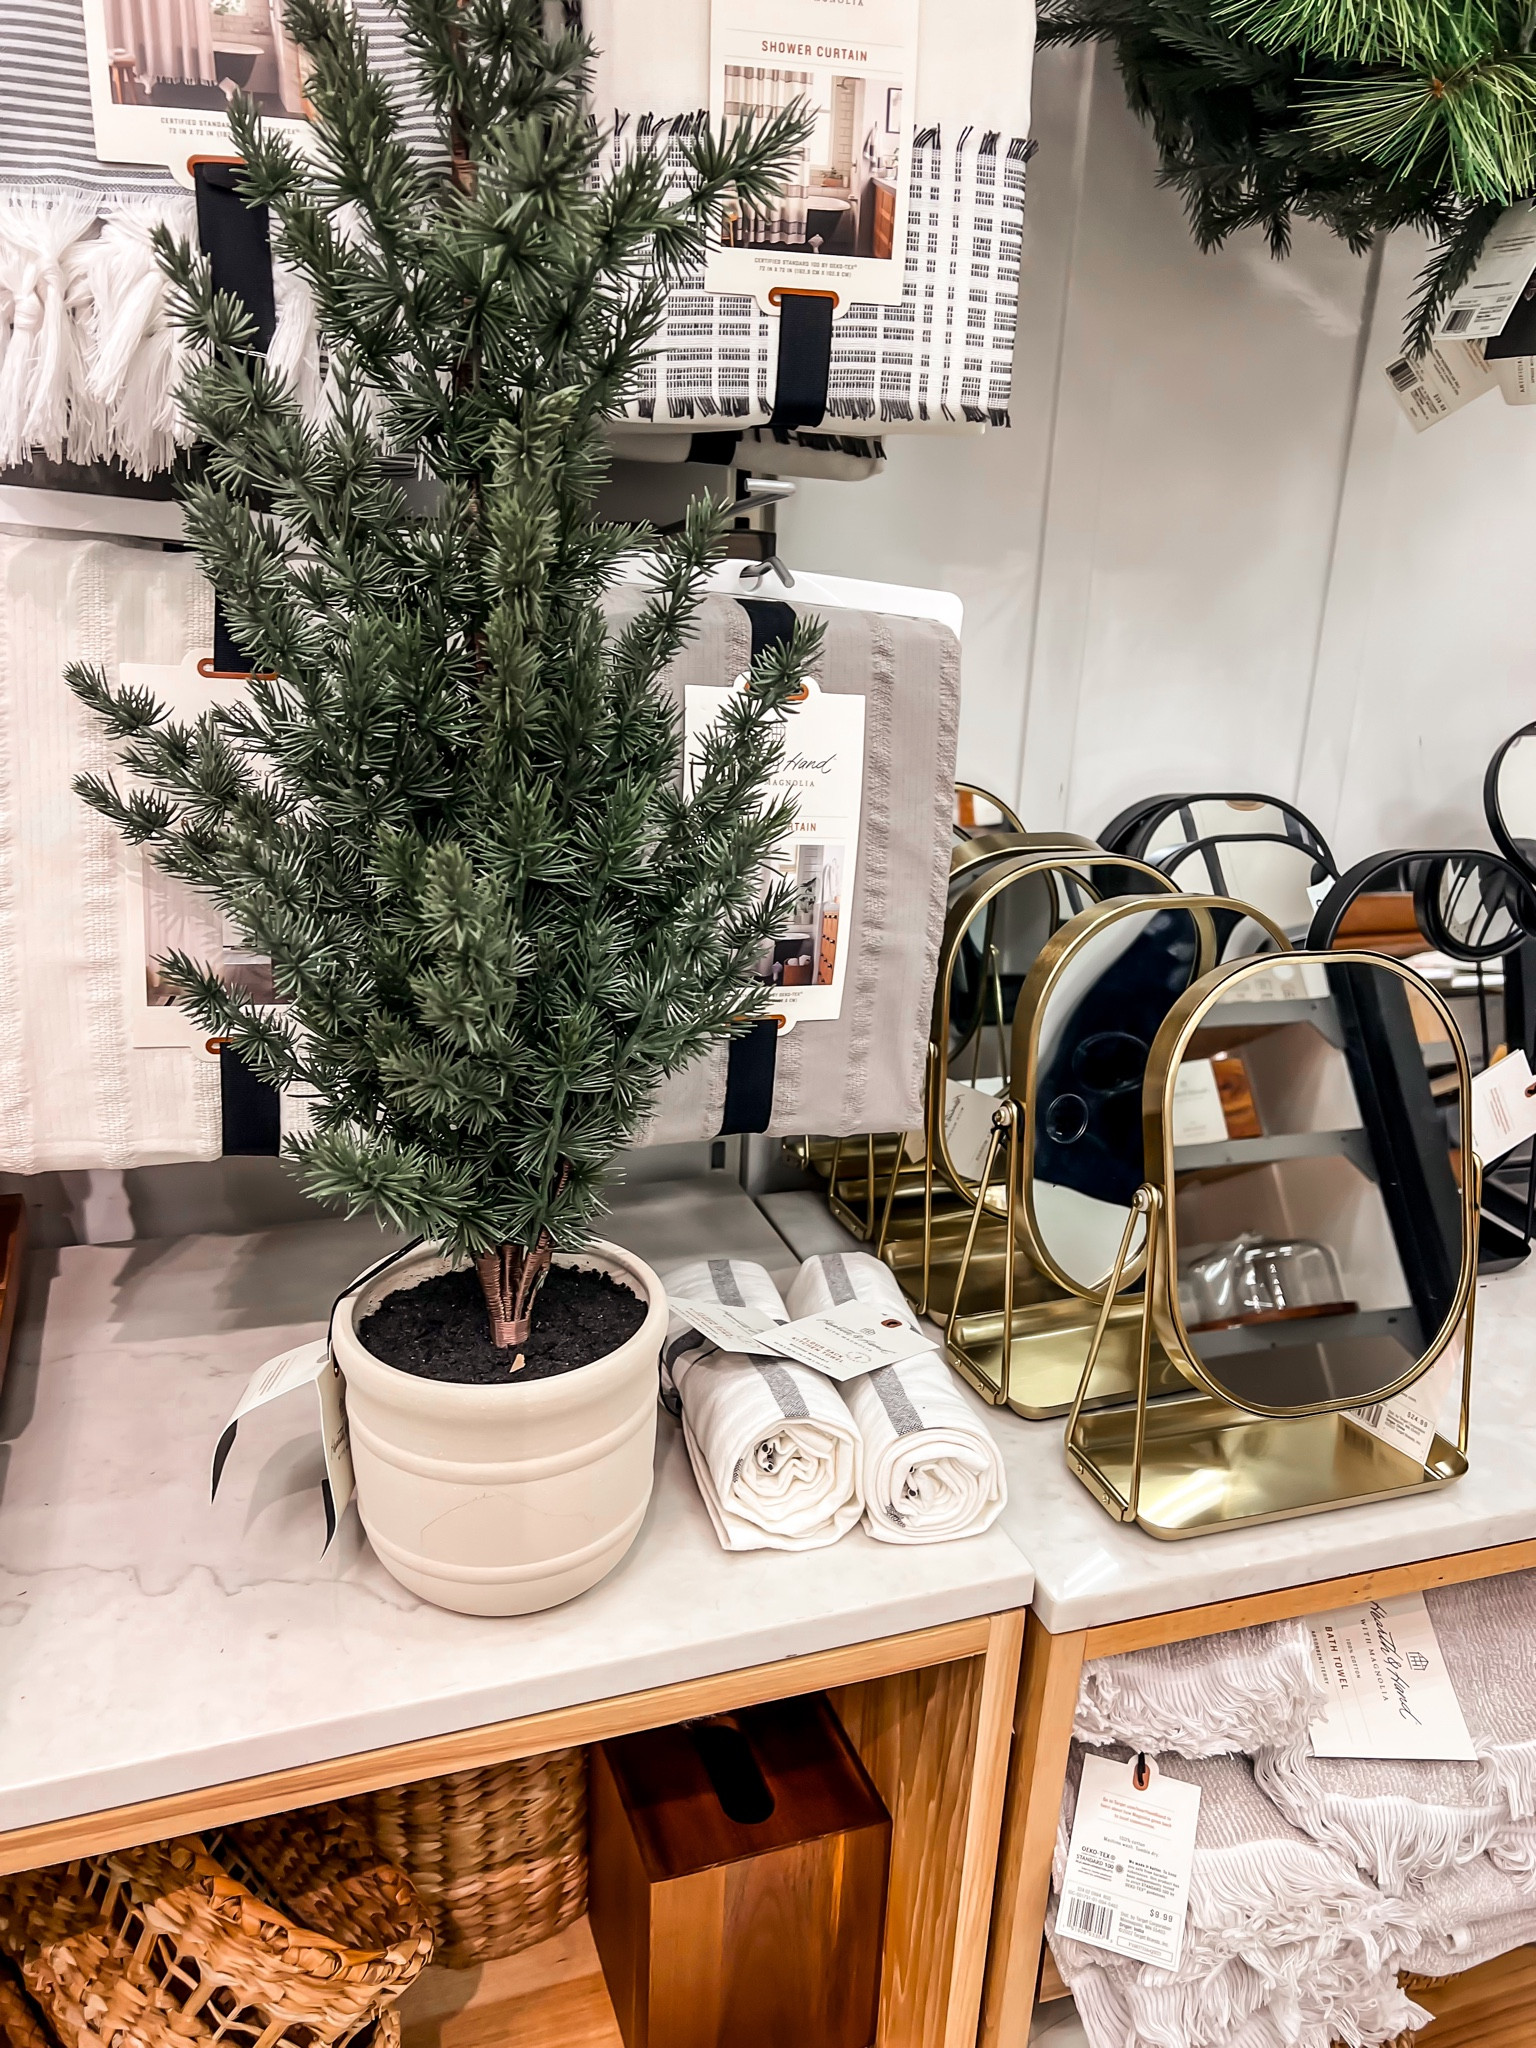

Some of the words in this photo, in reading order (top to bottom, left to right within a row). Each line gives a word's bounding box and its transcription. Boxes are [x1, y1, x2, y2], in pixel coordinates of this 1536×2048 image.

[762, 41, 811, 55] SHOWER
[817, 46, 867, 61] CURTAIN
[160, 117, 196, 126] CERTIFIED
[199, 119, 230, 128] STANDAR
[755, 257, 780, 265] CERTIFIED
[783, 259, 809, 267] STANDARD
[783, 752, 837, 773] Hand
[792, 1336, 820, 1353] KITCHEN
[822, 1351, 844, 1363] TOWEL
[803, 1337, 824, 1349] FLOUR
[826, 1348, 843, 1358] SACK
[1407, 1411, 1427, 1427] $24.99
[1370, 1600, 1403, 1661] Hearth
[1312, 1630, 1324, 1664] ABSORBENT
[1325, 1626, 1338, 1652] BATH
[1333, 1656, 1348, 1689] TOWEL
[1351, 1655, 1360, 1678] COTTON
[1360, 1619, 1372, 1644] WITH
[1369, 1649, 1389, 1701] MAGNOLIA
[1384, 1656, 1401, 1669] &
[1386, 1668, 1422, 1725] Hand
[1076, 1853, 1103, 1865] STANDARD
[1149, 1908, 1172, 1922] $9.99
